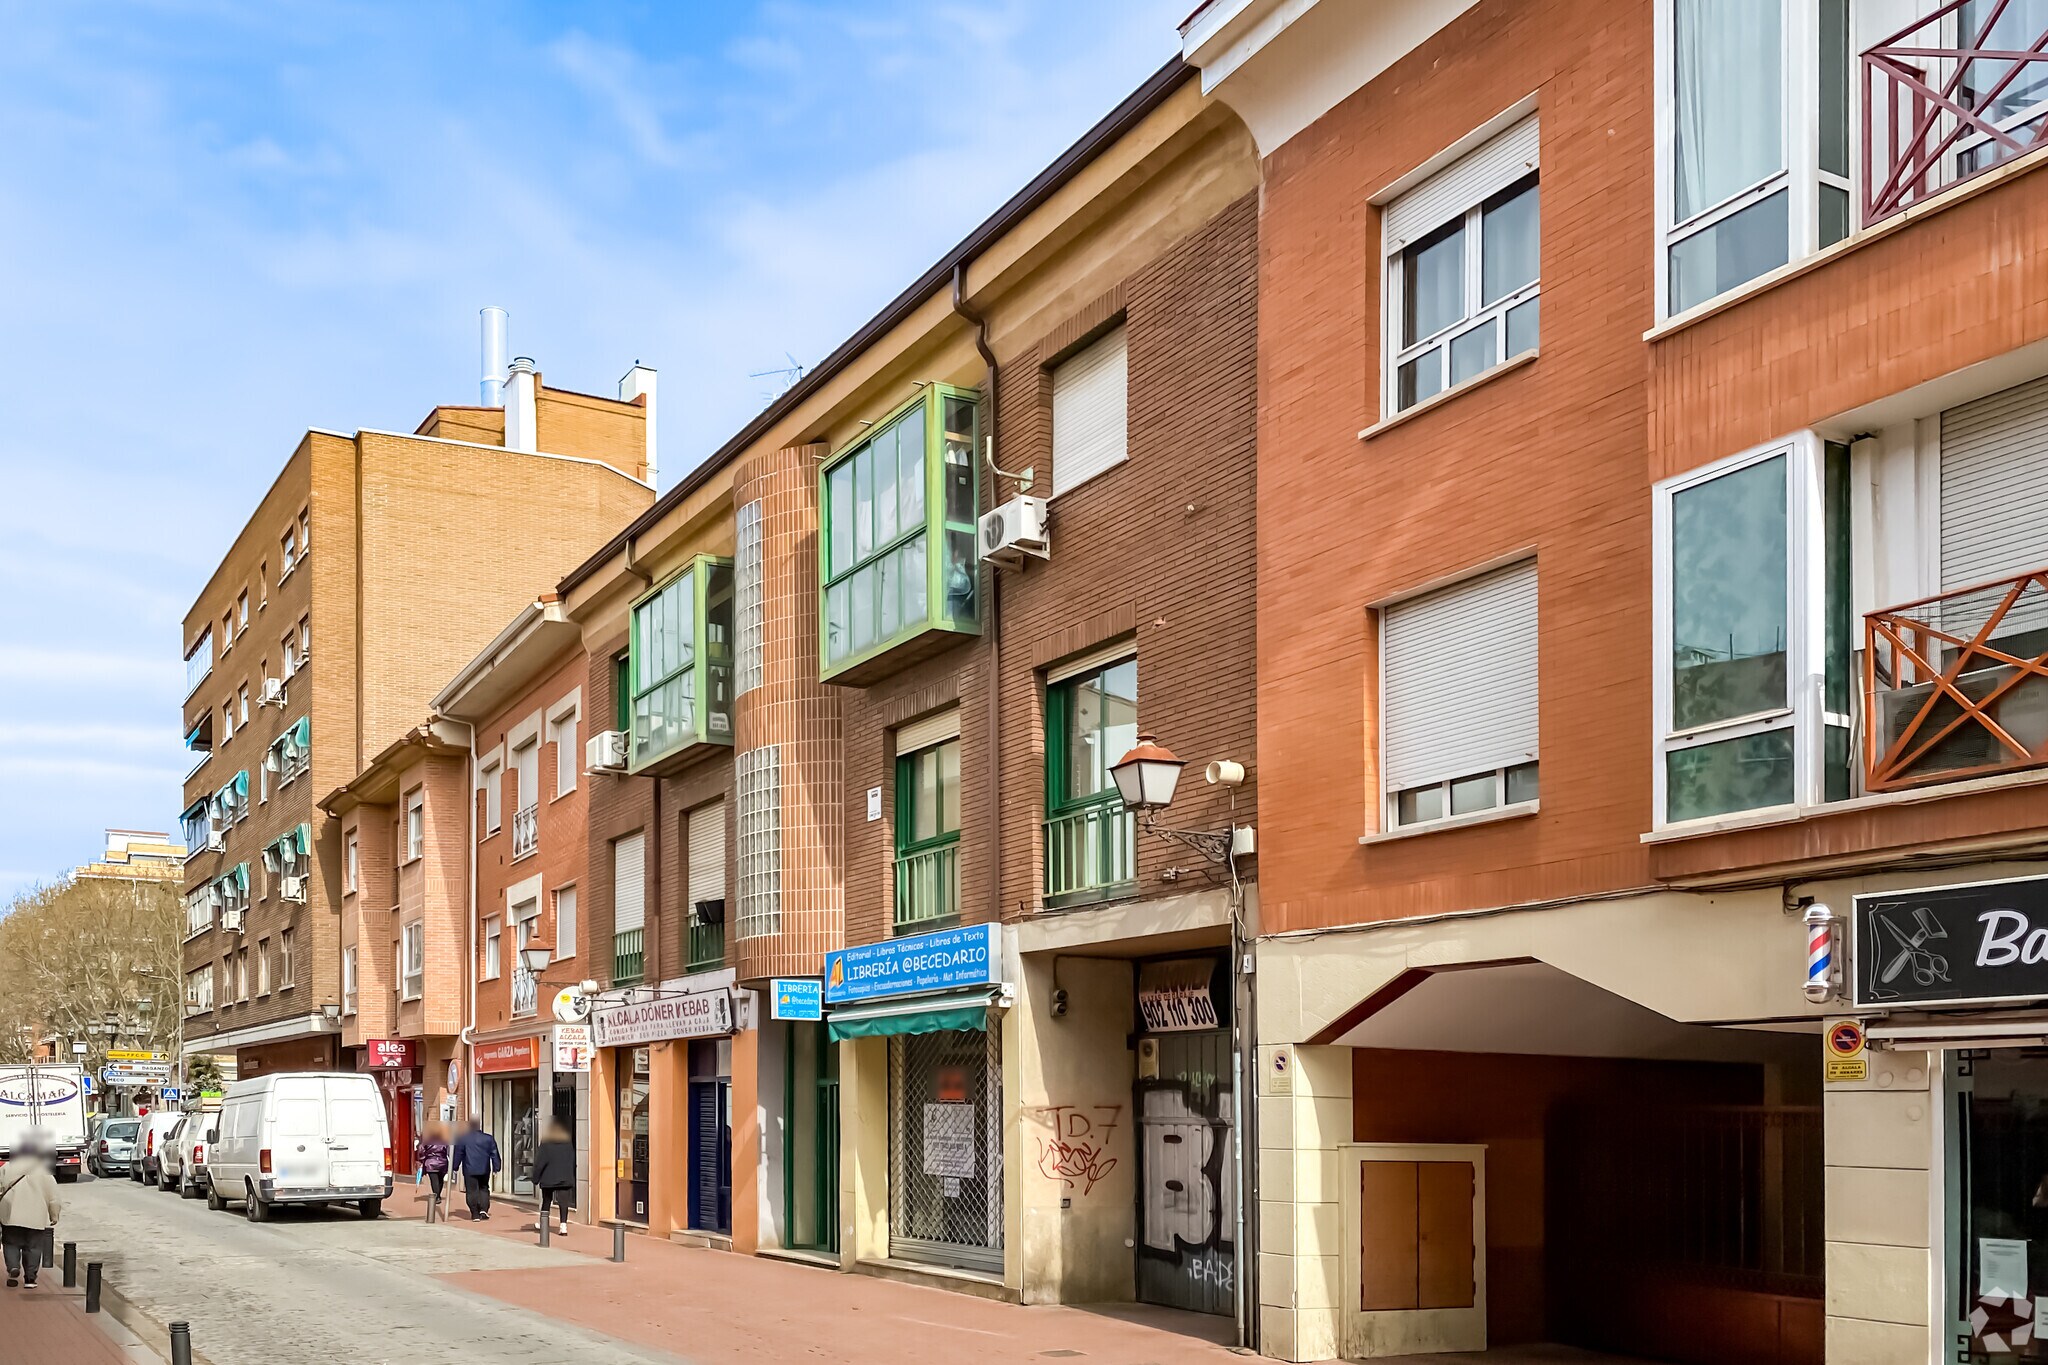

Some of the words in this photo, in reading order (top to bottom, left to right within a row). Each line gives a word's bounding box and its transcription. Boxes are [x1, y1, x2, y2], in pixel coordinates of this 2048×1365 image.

[846, 949, 872, 962] Editorial
[876, 946, 896, 957] Libros
[897, 942, 924, 953] Técnicos
[929, 938, 951, 948] Libros
[952, 935, 961, 944] de
[963, 931, 984, 941] Texto
[1977, 910, 2048, 967] Ba
[847, 957, 899, 981] LIBRERÍA
[902, 947, 986, 973] @BECEDARIO
[778, 983, 819, 994] LIBRERÍA
[607, 1010, 640, 1028] ALCALA
[641, 1003, 674, 1022] DÖNER
[675, 999, 710, 1019] KEBAB
[1143, 1000, 1168, 1028] 902
[1167, 999, 1188, 1027] 110
[1188, 996, 1214, 1026] 300
[377, 1041, 406, 1053] alea
